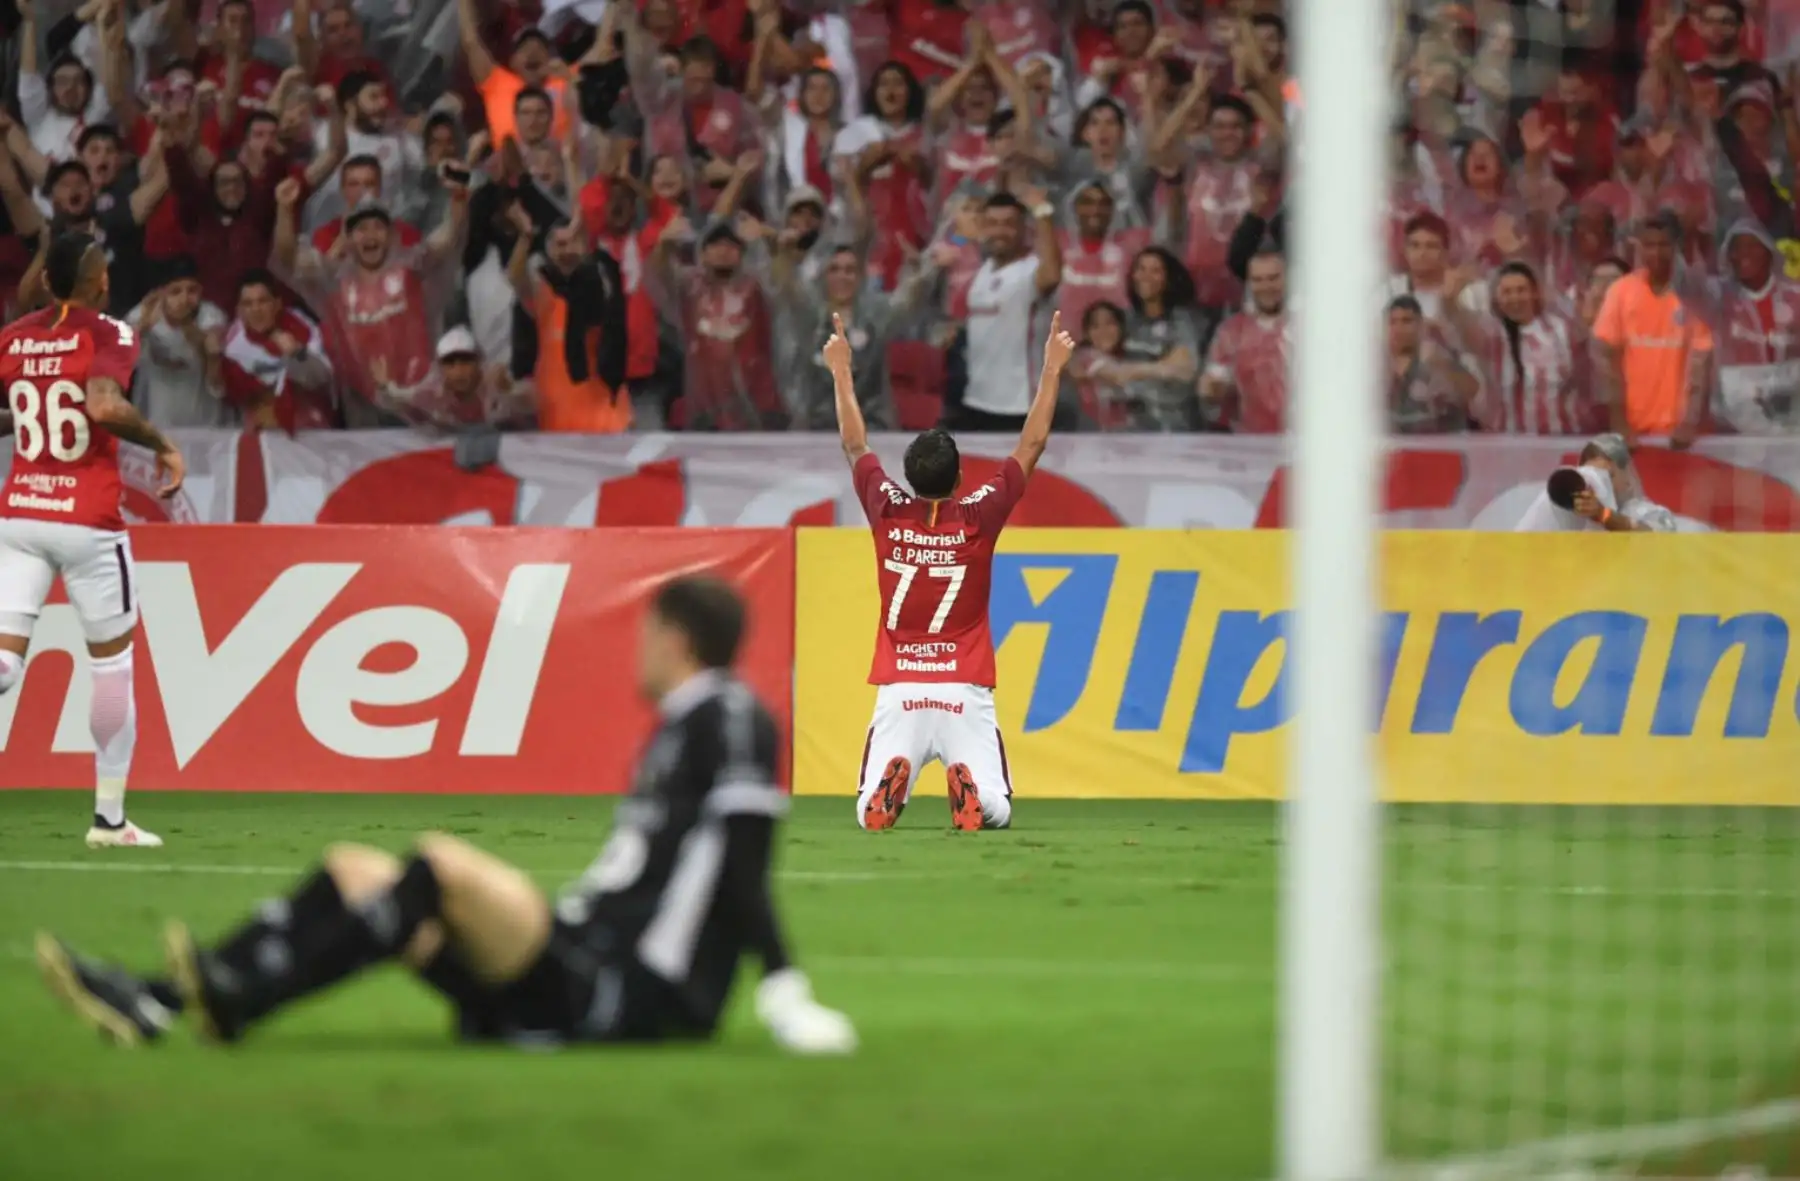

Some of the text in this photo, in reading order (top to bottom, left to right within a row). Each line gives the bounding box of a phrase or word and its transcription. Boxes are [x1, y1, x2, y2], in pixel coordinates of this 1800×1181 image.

[9, 380, 90, 462] 86
[8, 493, 76, 512] Unimed
[903, 529, 967, 546] Banrisul
[893, 548, 957, 565] G. PAREDE
[884, 559, 967, 633] 77
[896, 642, 957, 654] LAGHETTO
[896, 659, 957, 672] Unimed
[1113, 570, 1800, 773] Ipran
[902, 697, 964, 715] Unimed
